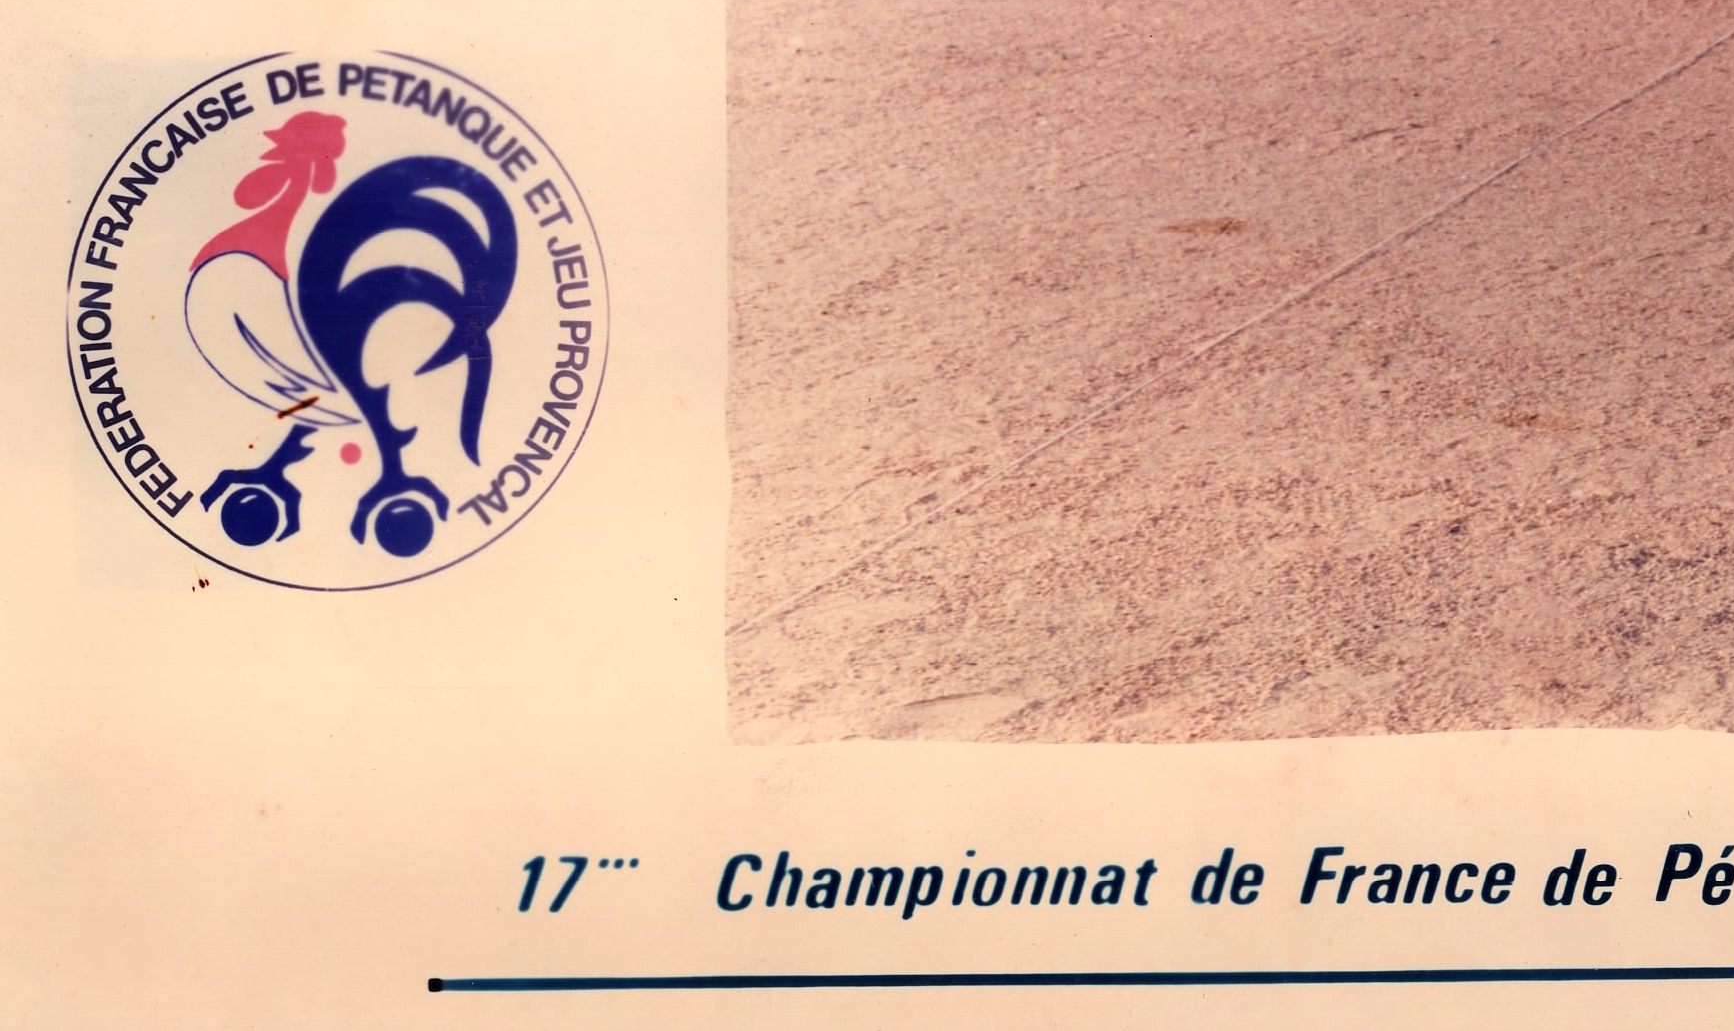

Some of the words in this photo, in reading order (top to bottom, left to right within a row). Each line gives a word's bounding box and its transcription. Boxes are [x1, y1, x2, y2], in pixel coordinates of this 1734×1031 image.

[266, 62, 325, 105] DE
[338, 63, 538, 183] PETANQUE
[85, 82, 254, 270] FRANCAISE
[522, 178, 574, 228] ET
[547, 236, 592, 310] JEU
[77, 280, 195, 519] FEDERATION
[456, 320, 592, 526] PROVENCAL
